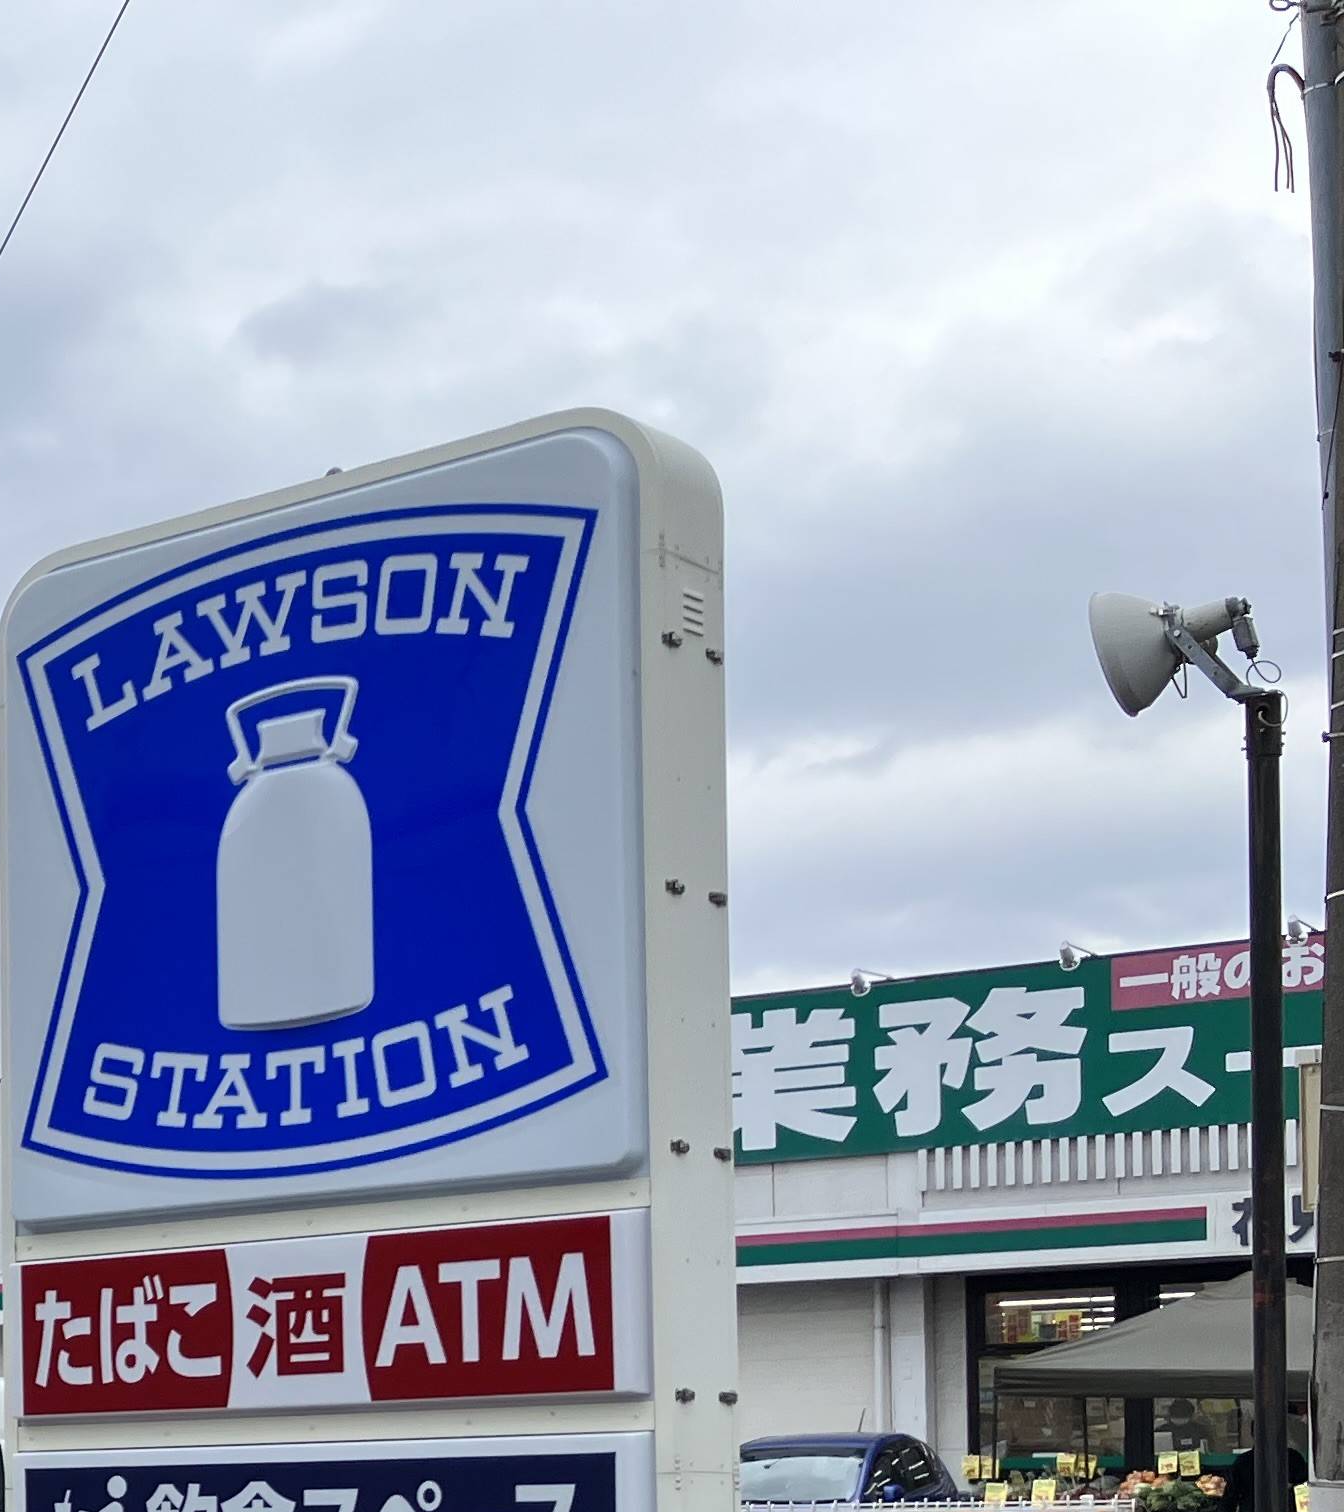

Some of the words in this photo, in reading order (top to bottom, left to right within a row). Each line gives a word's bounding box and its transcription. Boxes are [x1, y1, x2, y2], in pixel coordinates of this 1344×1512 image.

[71, 552, 531, 731] LAWSON
[83, 984, 530, 1130] STATION
[35, 1275, 221, 1388] たばこ
[246, 1272, 346, 1378] 酒
[376, 1253, 596, 1368] ATM
